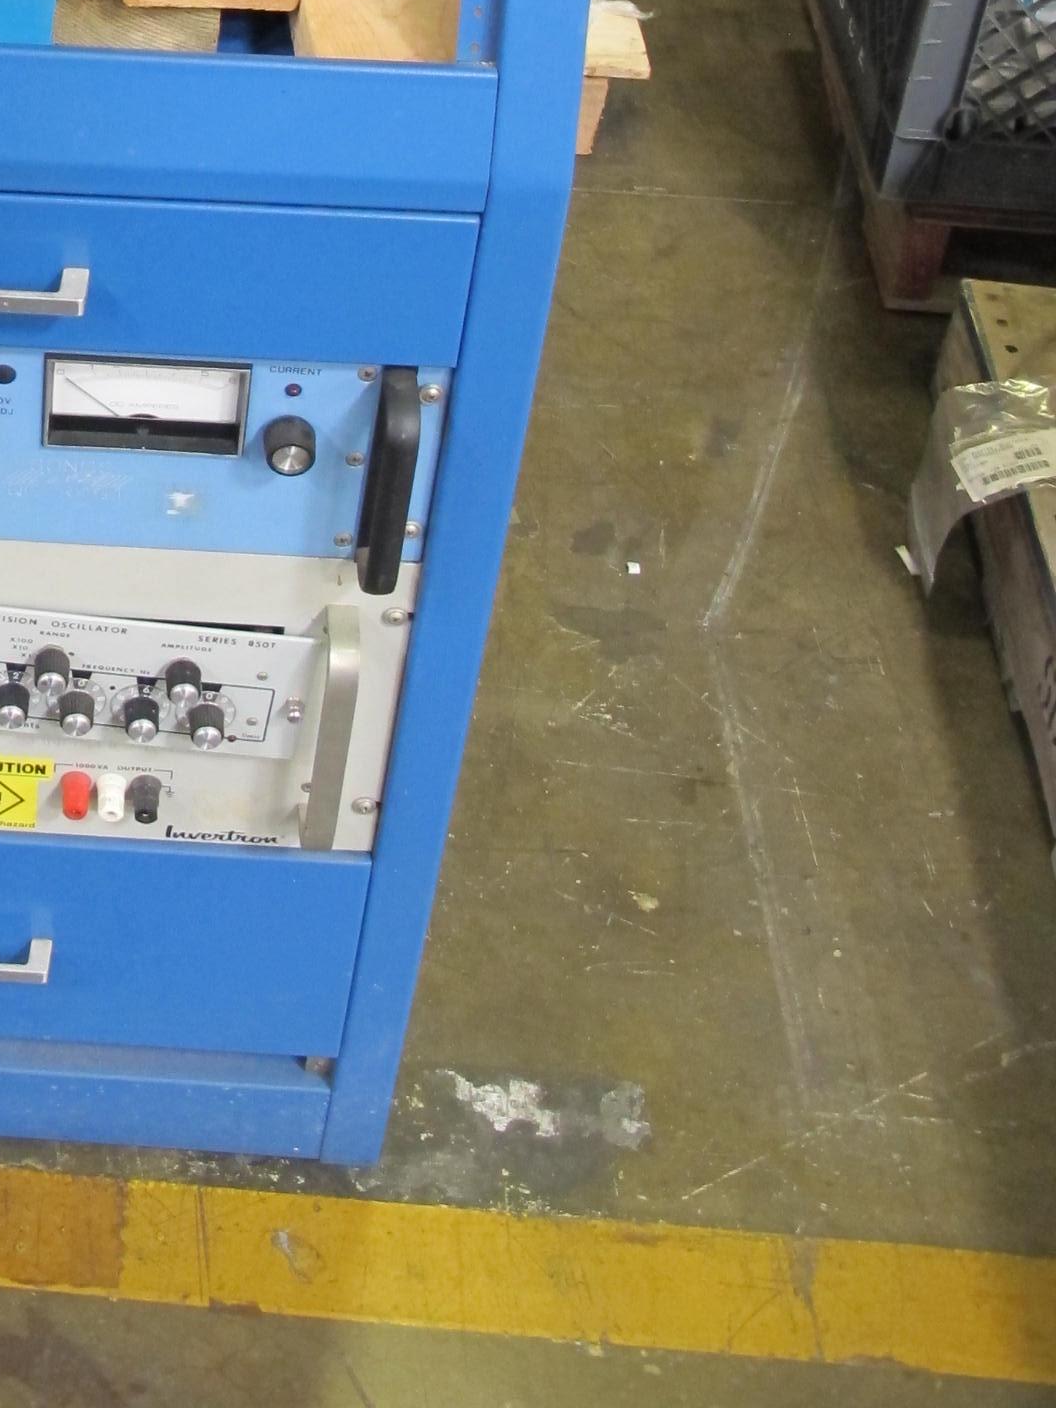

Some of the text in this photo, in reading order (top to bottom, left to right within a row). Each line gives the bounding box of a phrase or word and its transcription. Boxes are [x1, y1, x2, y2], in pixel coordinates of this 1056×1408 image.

[269, 365, 323, 376] CURRENT
[39, 629, 71, 638] RANGE
[51, 620, 129, 636] OSCILLATOR
[198, 635, 238, 646] SERIES
[81, 663, 135, 674] FREQUENCY
[0, 820, 36, 829] hazard
[165, 824, 279, 844] Invertron
